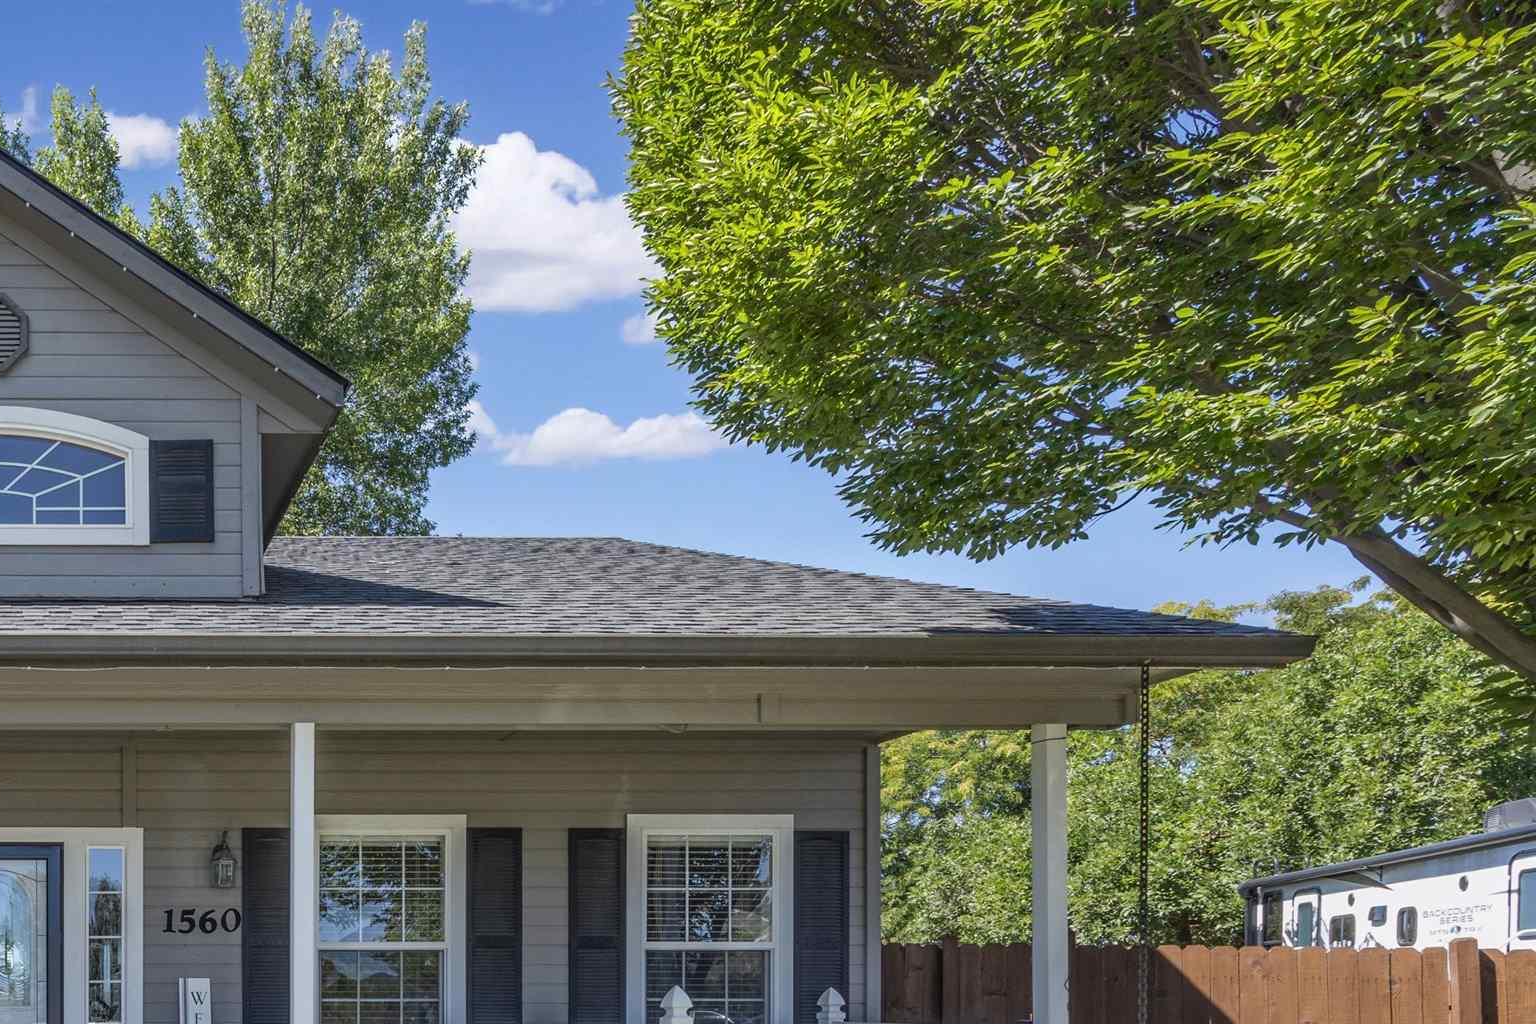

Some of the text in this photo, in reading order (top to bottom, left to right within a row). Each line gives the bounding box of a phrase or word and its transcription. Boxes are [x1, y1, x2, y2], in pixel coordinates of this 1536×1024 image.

[1423, 904, 1494, 919] BACKCOUNTRY
[162, 908, 241, 934] 1560
[1440, 915, 1473, 925] SERIES
